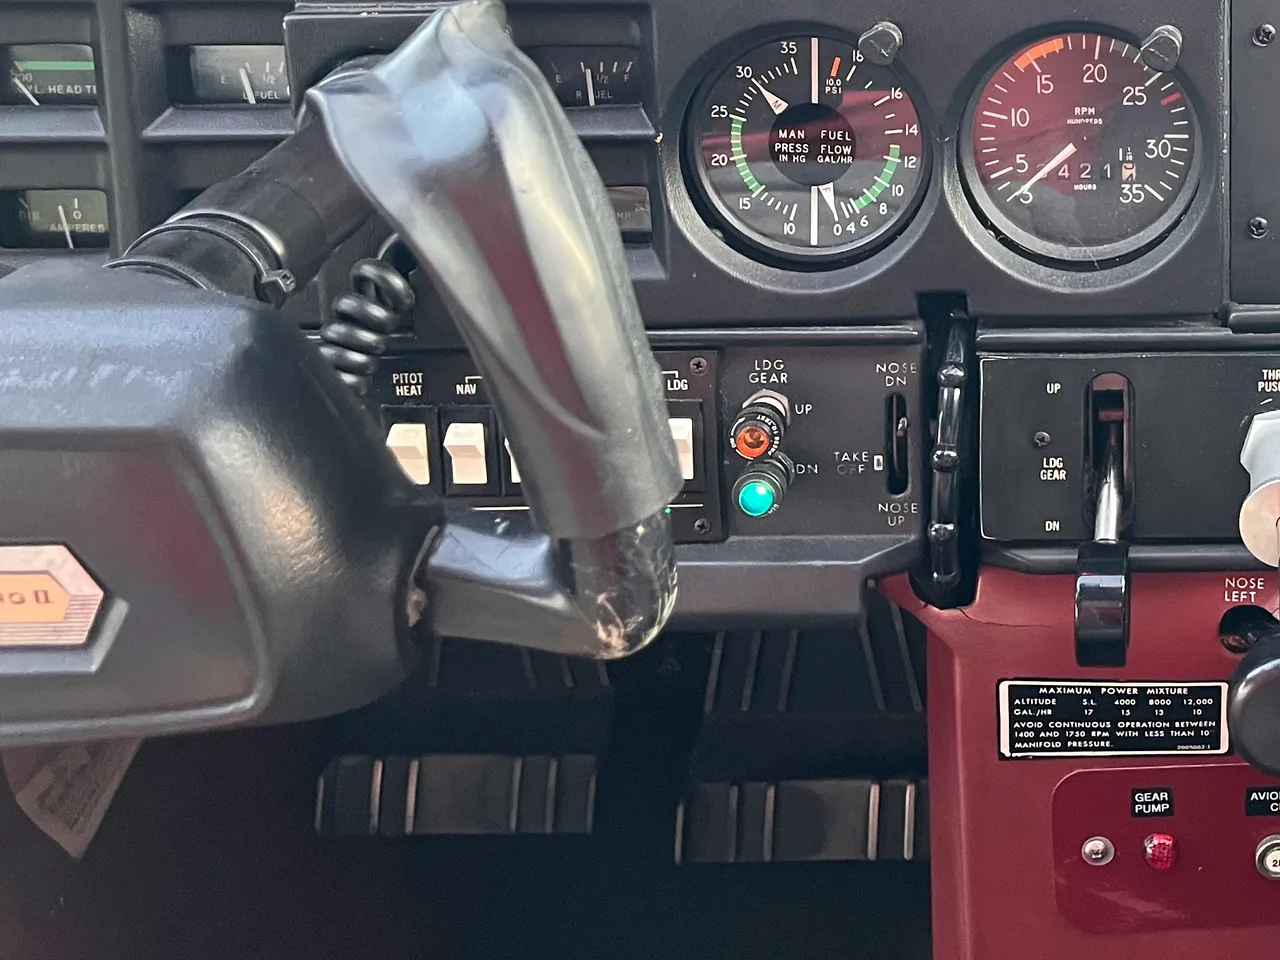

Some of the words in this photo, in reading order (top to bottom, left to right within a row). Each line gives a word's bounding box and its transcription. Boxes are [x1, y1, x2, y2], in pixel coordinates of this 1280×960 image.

[1082, 64, 1109, 84] 20
[1074, 106, 1095, 116] RPM
[778, 129, 805, 140] MAN
[821, 130, 851, 141] FUEL
[775, 143, 809, 153] PRESS
[820, 144, 852, 154] FLOW
[1144, 139, 1172, 159] 30
[817, 154, 853, 164] GAL/HR
[1118, 183, 1146, 204] 35
[754, 359, 785, 371] LDG
[875, 362, 917, 373] NOSE
[393, 372, 423, 385] PITOT
[748, 371, 789, 385] GEAR
[885, 374, 908, 386] DN
[396, 384, 423, 396] HEAT
[456, 384, 477, 395] NAV
[668, 379, 688, 391] LDG
[1046, 383, 1061, 394] UP
[795, 403, 813, 415] UP
[1043, 457, 1063, 468] LDG
[796, 463, 818, 475] DN
[1040, 469, 1067, 480] GEAR
[878, 503, 918, 514] NOSE
[887, 515, 905, 526] UP
[1045, 520, 1060, 532] DN
[1225, 578, 1265, 589] NOSE
[1225, 590, 1257, 602] LEFT
[1039, 687, 1092, 695] MAXIMUM
[1101, 687, 1138, 695] POWER
[1146, 687, 1189, 695] MIXTURE
[1013, 721, 1043, 729] AVOID
[1048, 721, 1111, 729] CONTINUOUS
[1117, 721, 1170, 729] OPERATION
[1174, 720, 1216, 728] BETWEEN
[1014, 730, 1035, 738] 1400
[1039, 730, 1060, 738] AND
[1065, 730, 1086, 738] 1750
[1090, 730, 1110, 738] RPM
[1144, 730, 1166, 738] LESS
[1170, 729, 1196, 738] THAN
[1014, 740, 1062, 749] MANIFOLD
[1066, 740, 1114, 749] PRESSURE.
[1135, 792, 1168, 803] GEAR
[1134, 803, 1170, 814] PUMP
